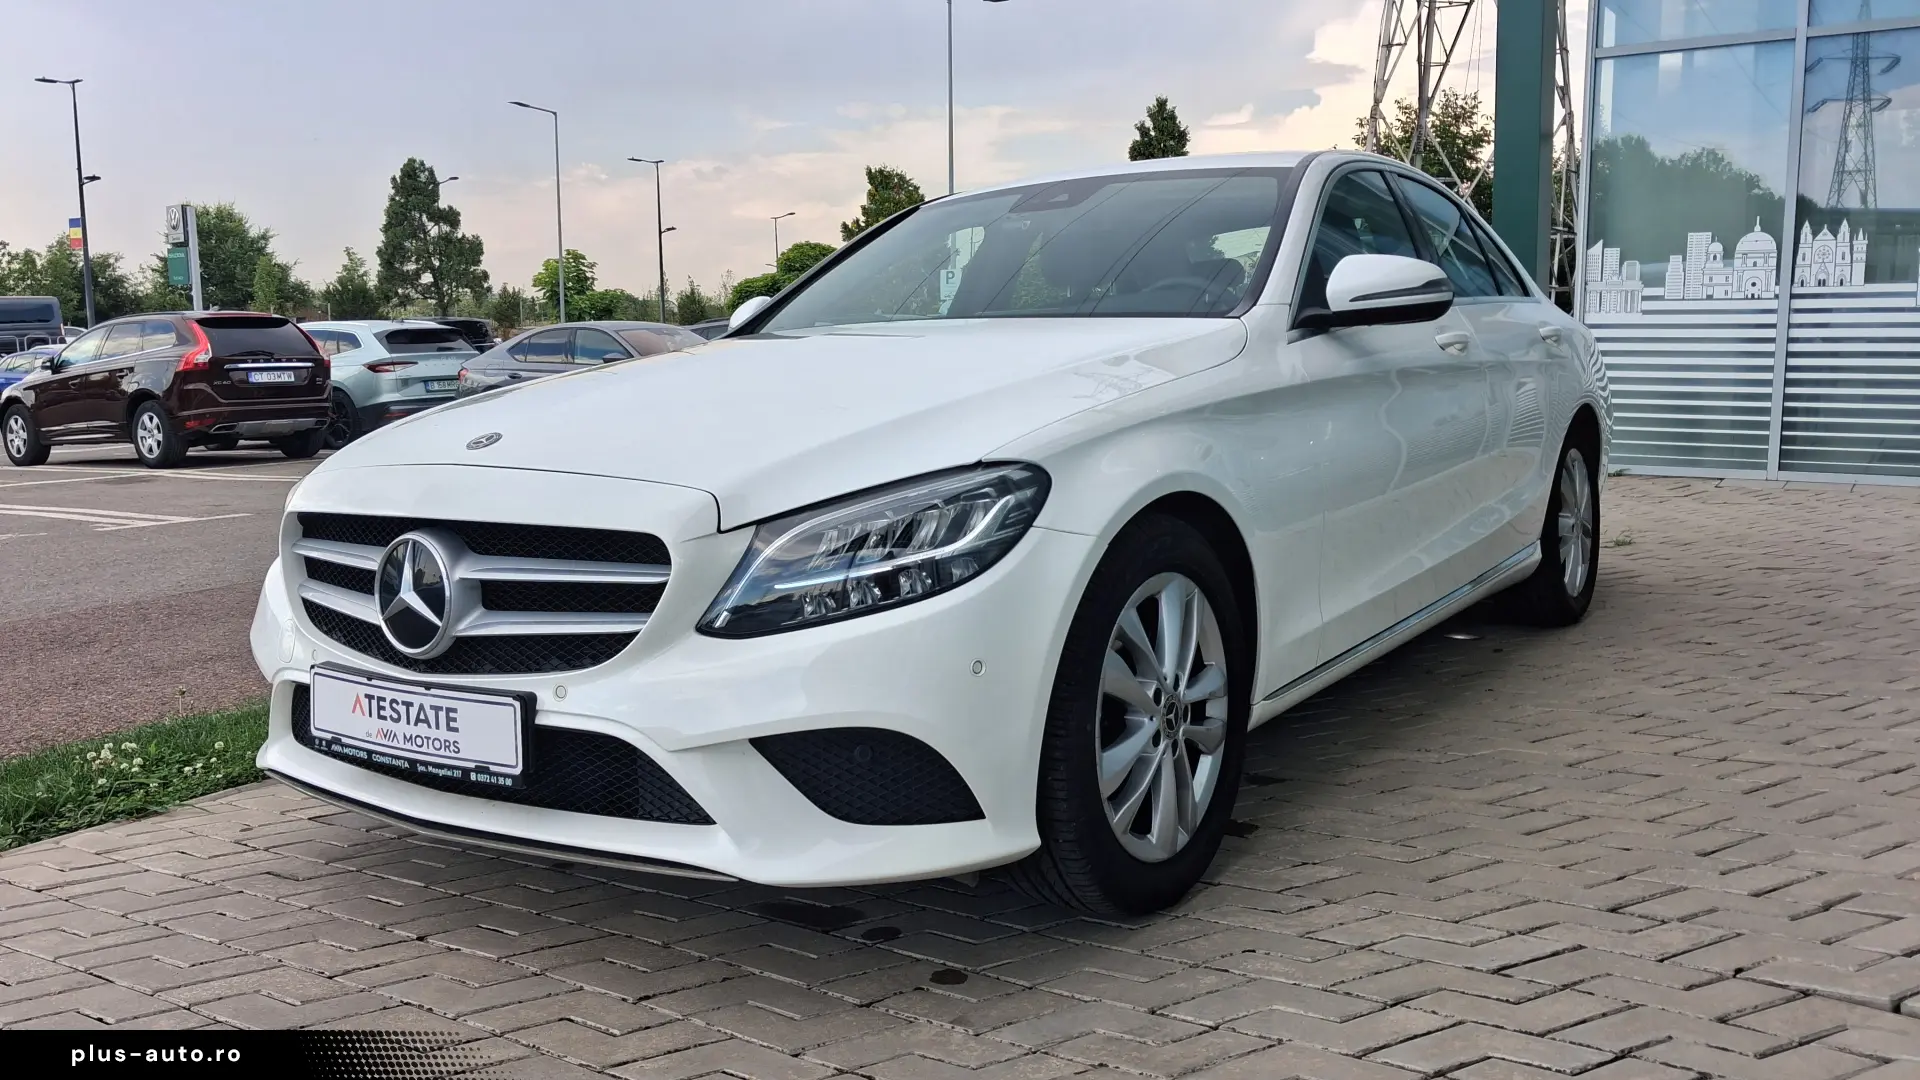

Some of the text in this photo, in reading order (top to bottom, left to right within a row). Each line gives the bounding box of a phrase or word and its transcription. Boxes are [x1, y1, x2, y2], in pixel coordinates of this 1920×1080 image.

[945, 270, 955, 285] P
[351, 692, 460, 733] ATESTATE
[365, 730, 373, 739] de
[403, 732, 461, 755] MOTORS
[476, 774, 490, 783] 0372
[490, 776, 498, 784] 41
